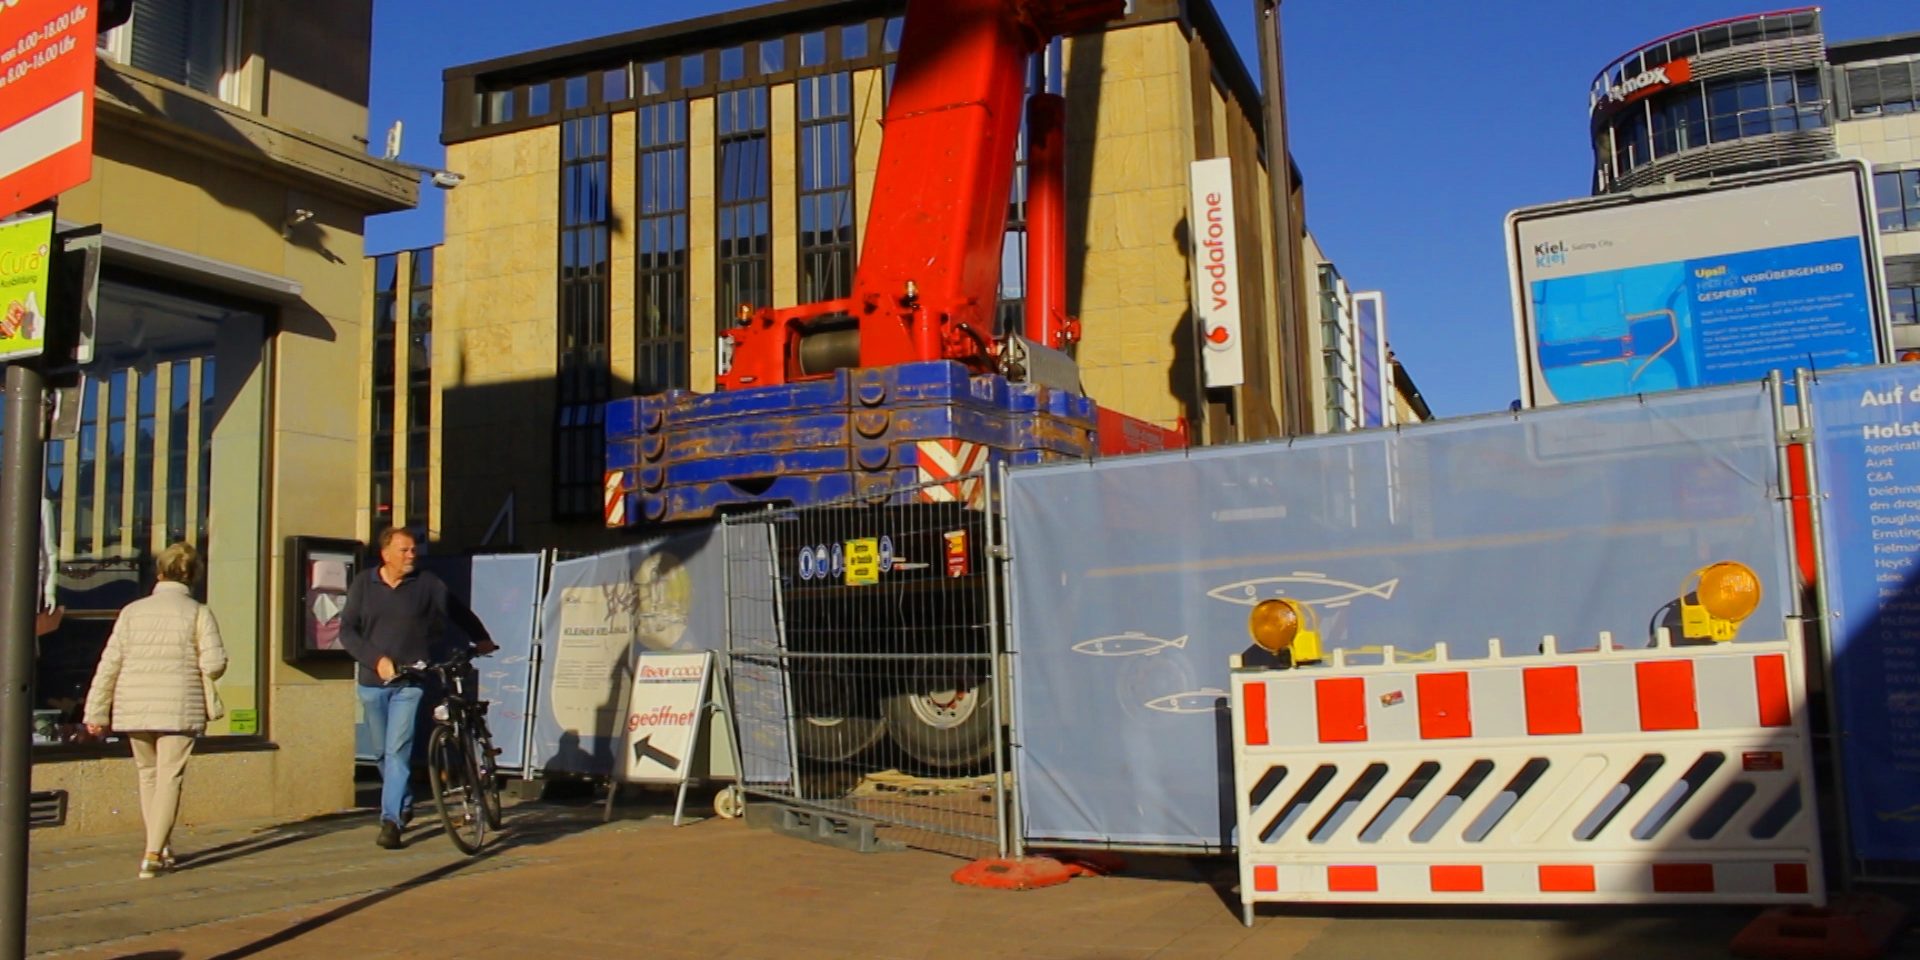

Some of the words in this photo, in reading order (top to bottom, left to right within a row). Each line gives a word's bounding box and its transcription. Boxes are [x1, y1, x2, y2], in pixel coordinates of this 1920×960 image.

[1, 47, 17, 64] von
[70, 5, 88, 25] Uhr
[59, 34, 76, 55] Uhr
[0, 250, 40, 275] Cura
[1203, 192, 1228, 311] vodafone
[1741, 263, 1844, 284] VORÜBERGEHEND
[1861, 385, 1904, 407] Auf
[1866, 458, 1894, 468] Aust
[1867, 471, 1894, 482] C&A
[627, 705, 695, 732] geöffnet
